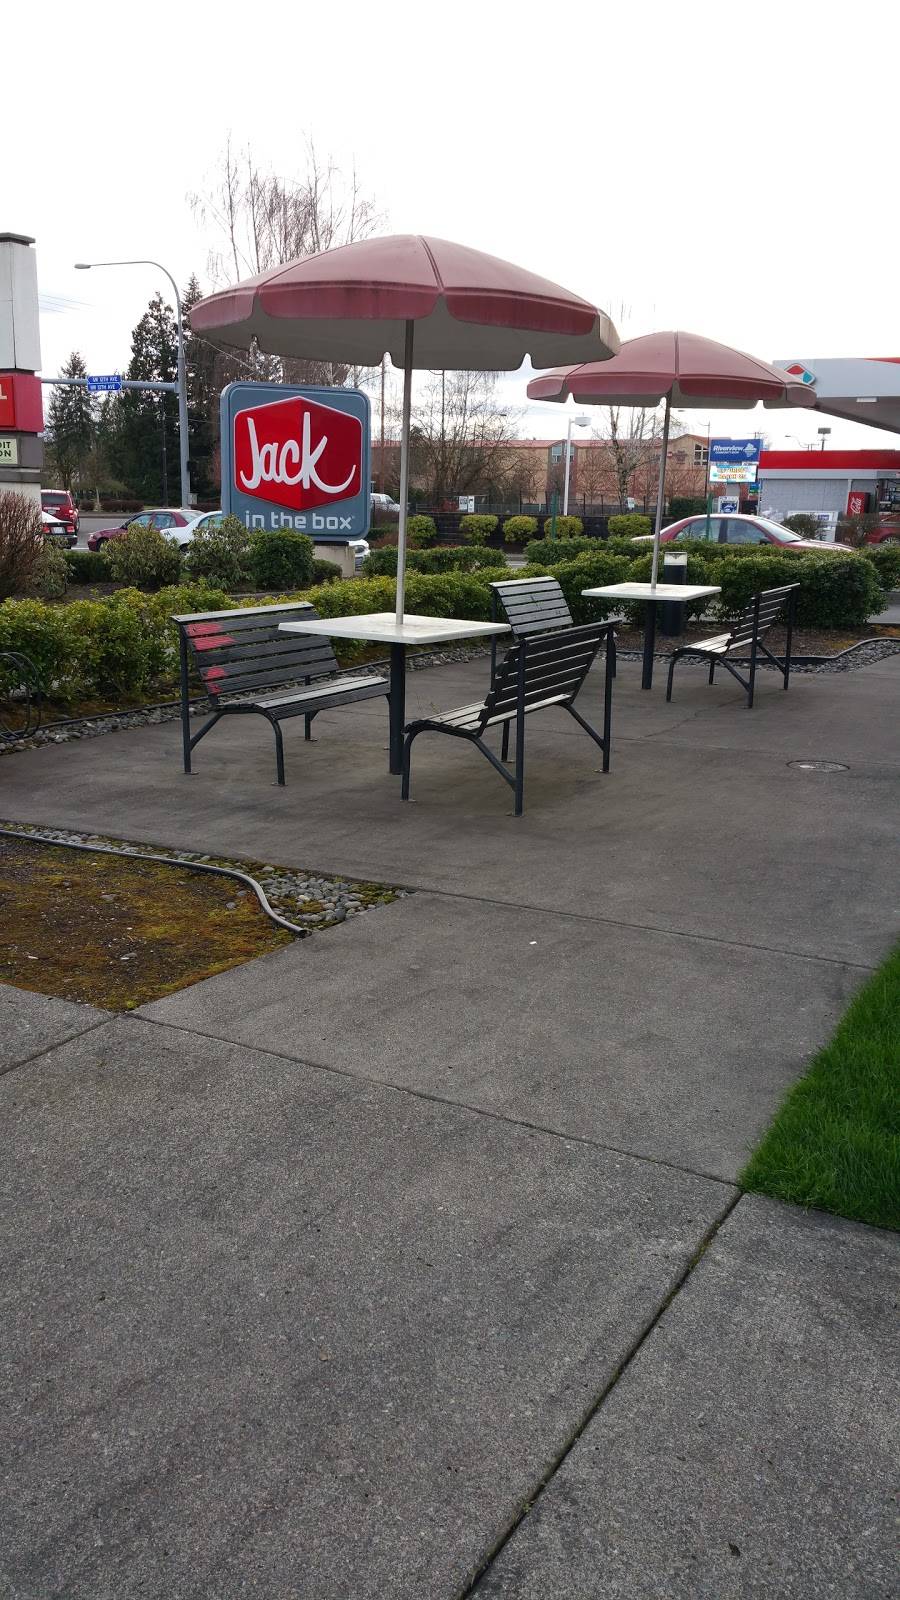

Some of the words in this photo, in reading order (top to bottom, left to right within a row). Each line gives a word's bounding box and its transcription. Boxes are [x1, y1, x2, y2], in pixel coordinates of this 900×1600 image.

[240, 411, 356, 494] Jack
[245, 510, 265, 528] in
[270, 511, 307, 532] the
[312, 512, 352, 530] box
